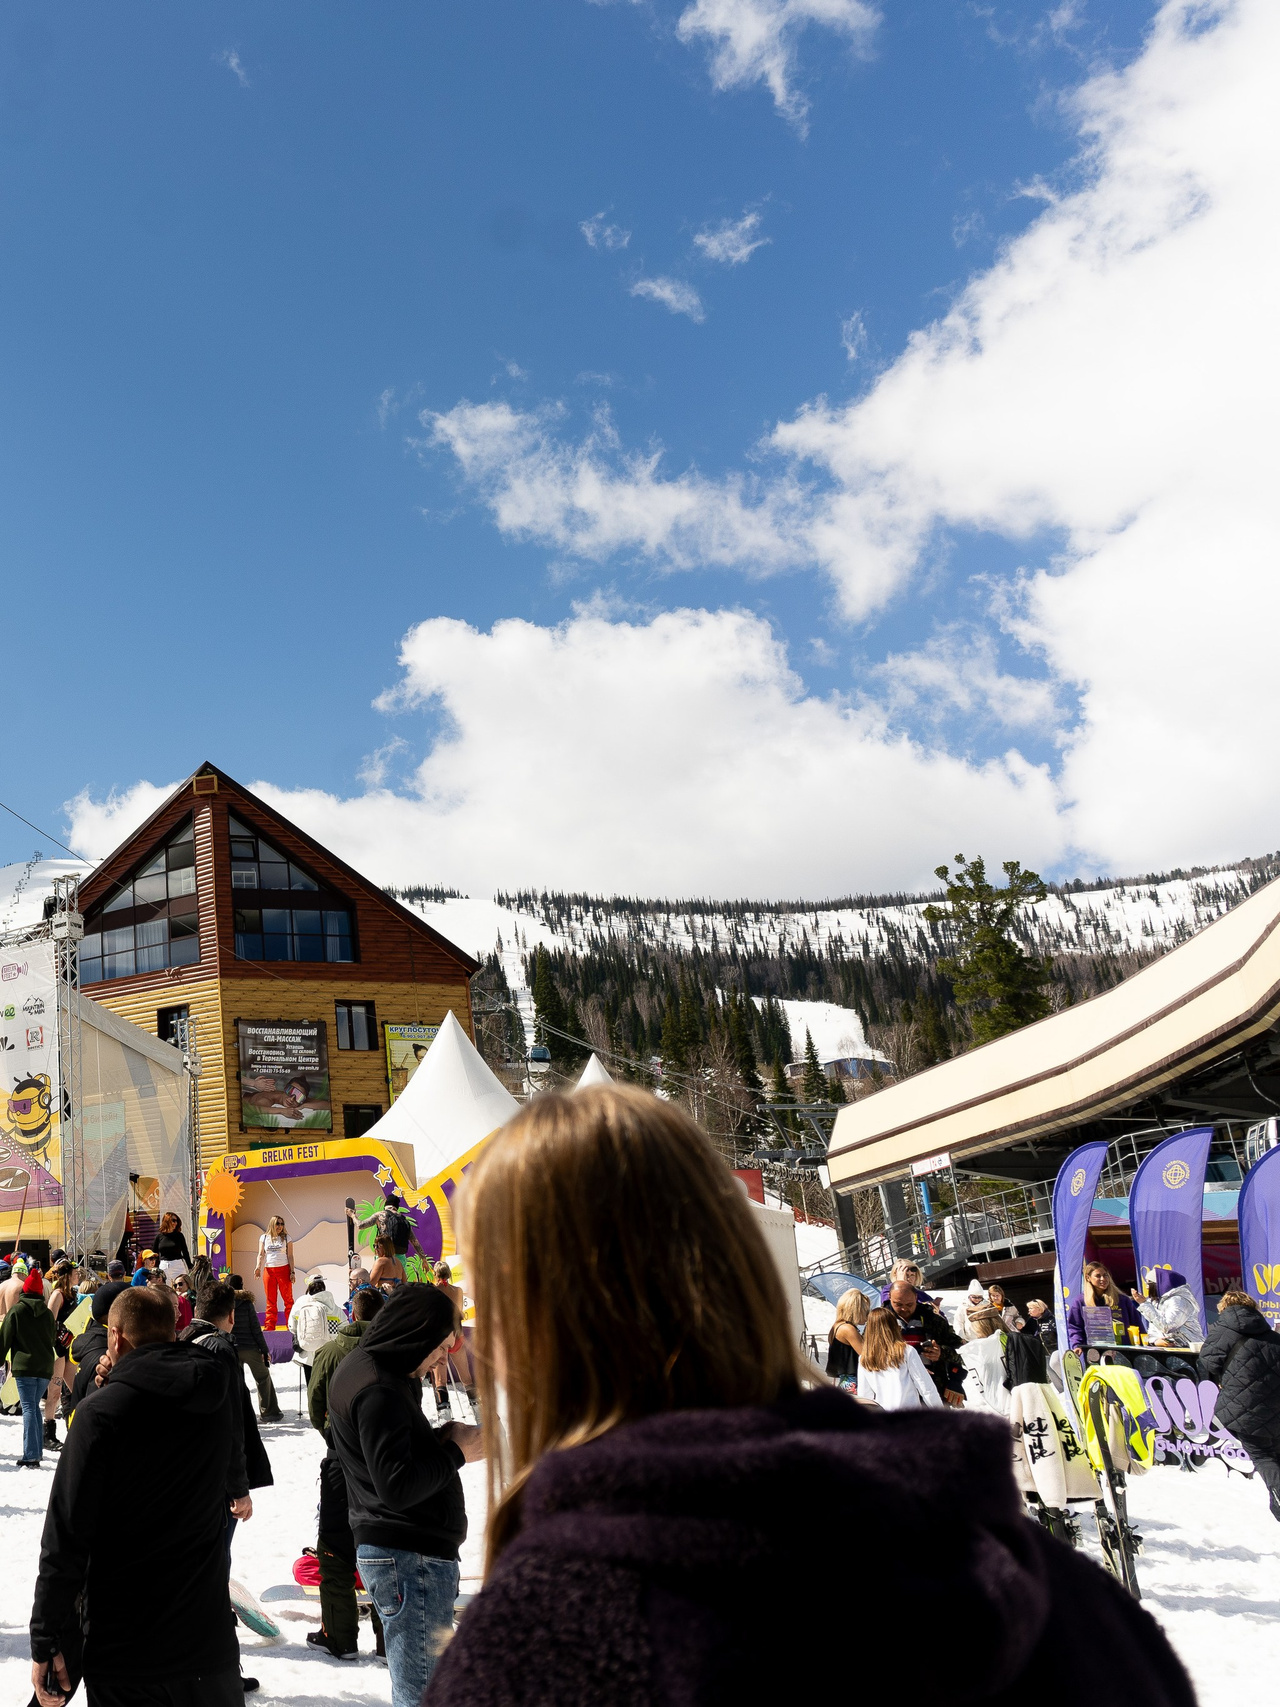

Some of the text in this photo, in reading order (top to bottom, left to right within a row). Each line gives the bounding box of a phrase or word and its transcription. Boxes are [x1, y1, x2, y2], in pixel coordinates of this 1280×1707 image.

[247, 1027, 318, 1036] ВОССТАНАВЛИВАЮЩИЙ
[263, 1035, 302, 1043] СПА-МАССАЖ
[262, 1145, 319, 1163] GRELKA FEST
